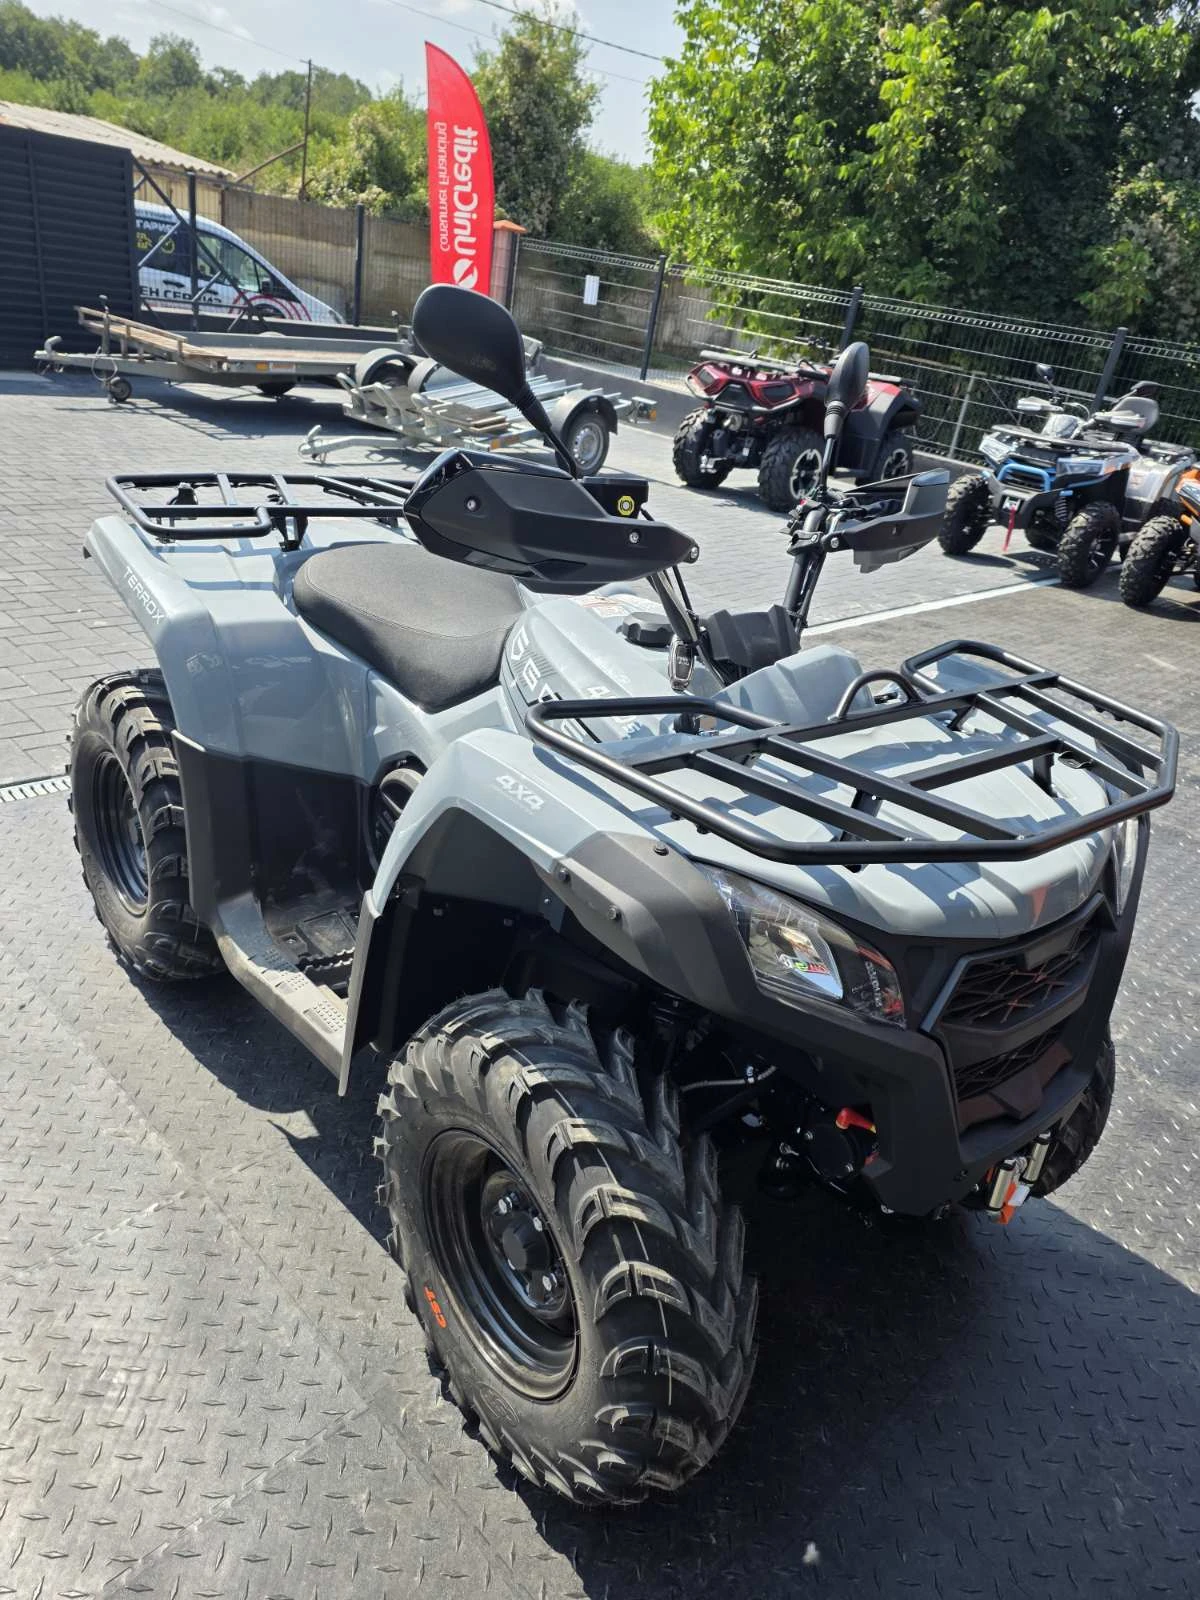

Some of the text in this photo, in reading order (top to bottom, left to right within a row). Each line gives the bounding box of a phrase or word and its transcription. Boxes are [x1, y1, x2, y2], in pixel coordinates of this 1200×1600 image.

[164, 289, 222, 303] СЕРИЗ
[123, 565, 165, 625] TERROX
[423, 1284, 447, 1329] CST
